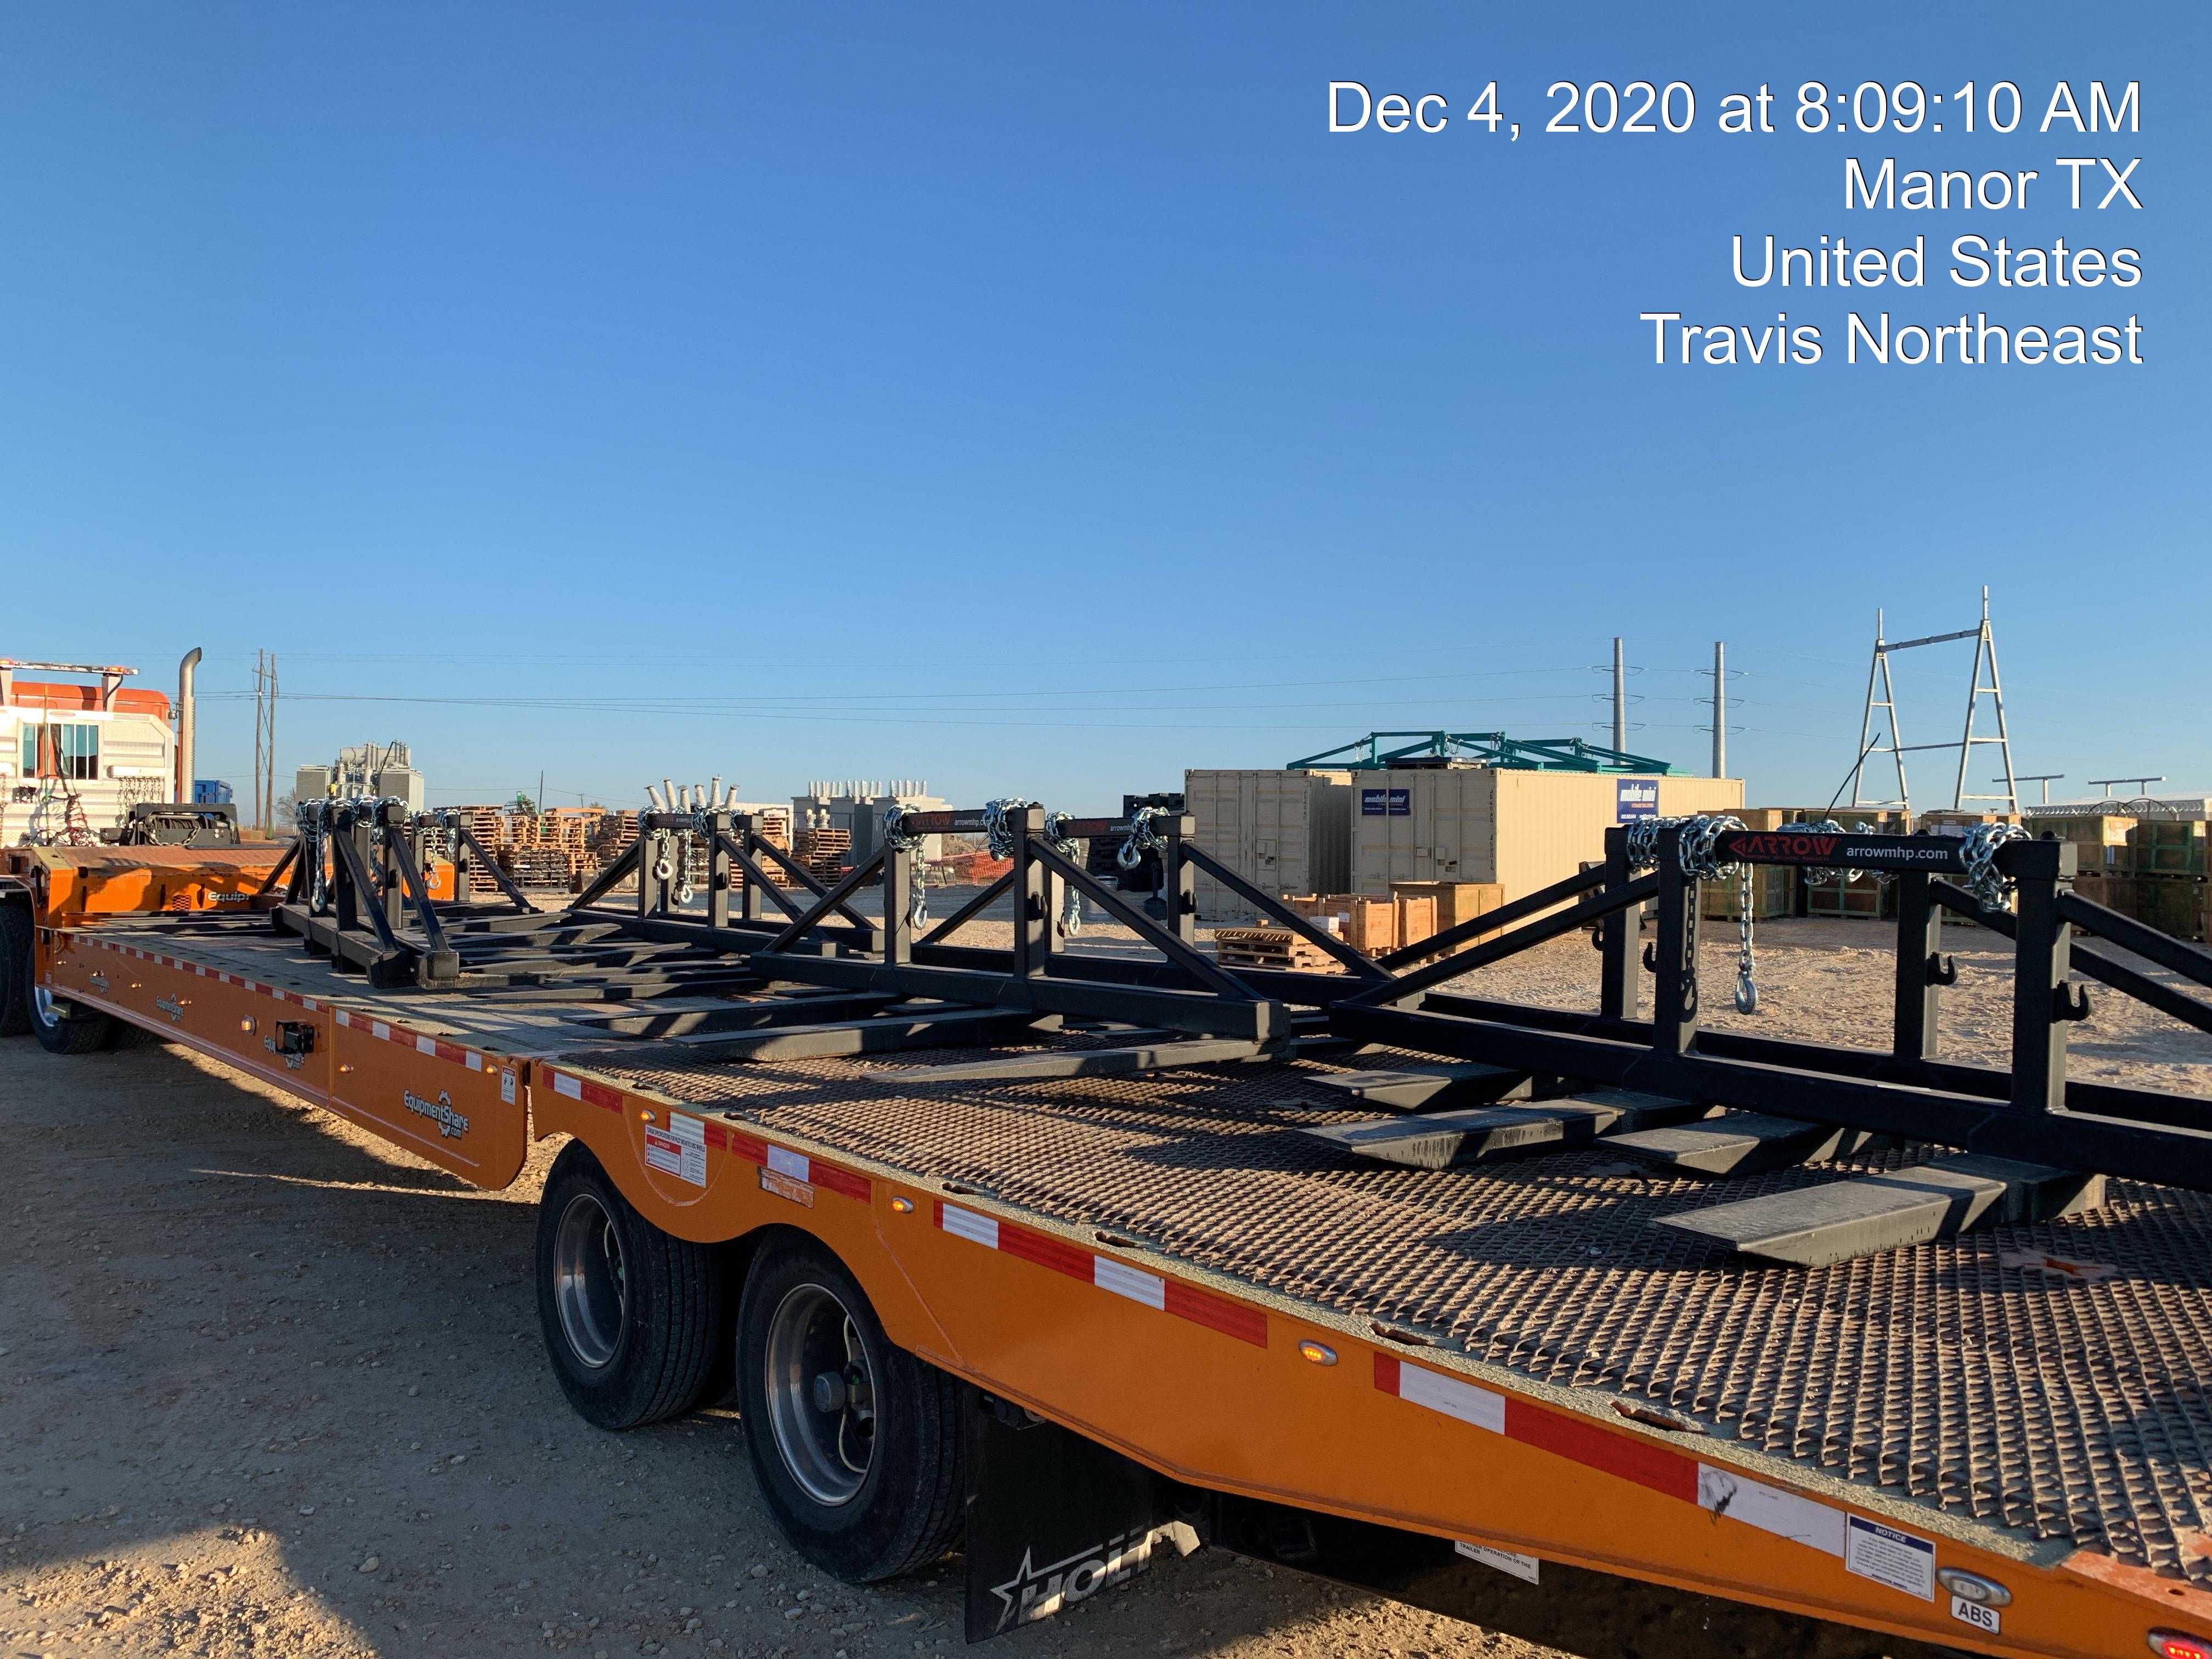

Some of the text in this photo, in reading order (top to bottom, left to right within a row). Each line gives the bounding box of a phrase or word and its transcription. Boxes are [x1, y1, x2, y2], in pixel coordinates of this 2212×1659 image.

[1746, 835, 1948, 861] ARROW arrowmhp.com
[404, 1089, 469, 1132] EquipmentShare
[1875, 1526, 1907, 1543] NOTICE
[1460, 1543, 1480, 1554] TRAILER
[1483, 1547, 1512, 1561] OPERATION
[1959, 1602, 1993, 1627] ABS
